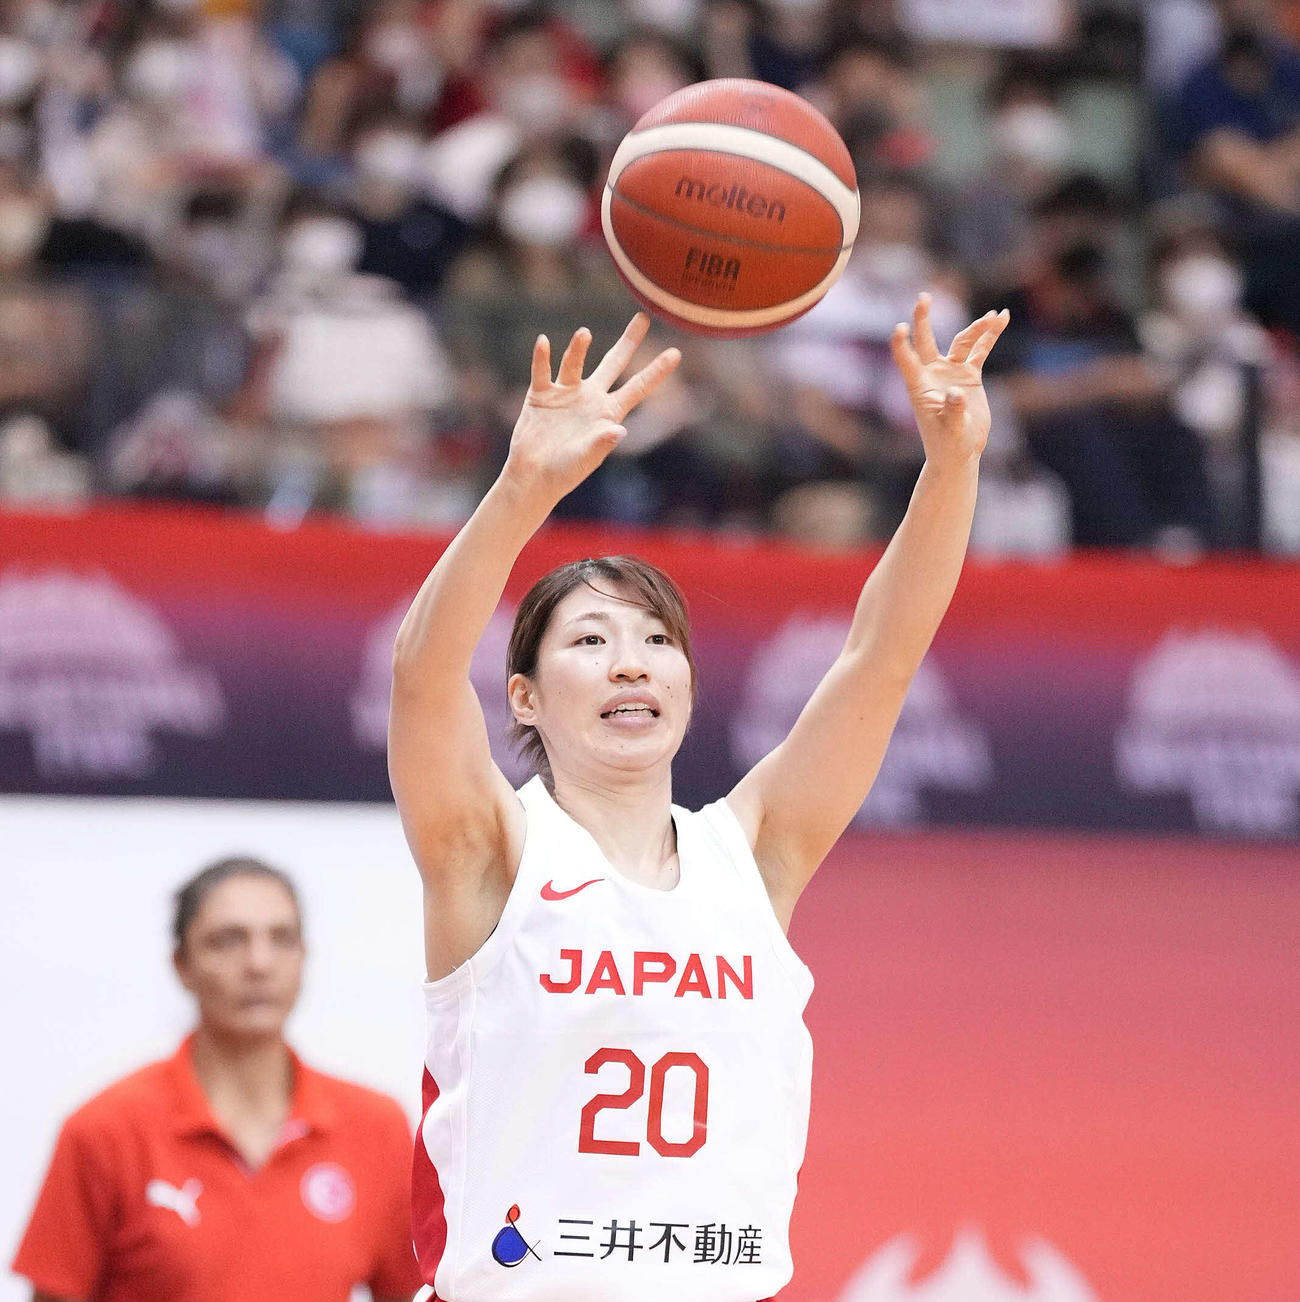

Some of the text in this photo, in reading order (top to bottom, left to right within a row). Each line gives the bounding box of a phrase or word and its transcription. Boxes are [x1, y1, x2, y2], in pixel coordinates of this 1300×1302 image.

[675, 177, 787, 223] molten
[685, 247, 741, 280] FIBA
[539, 948, 754, 1000] JAPAN
[578, 1047, 710, 1158] 20
[553, 1218, 763, 1266] 三井不動産
